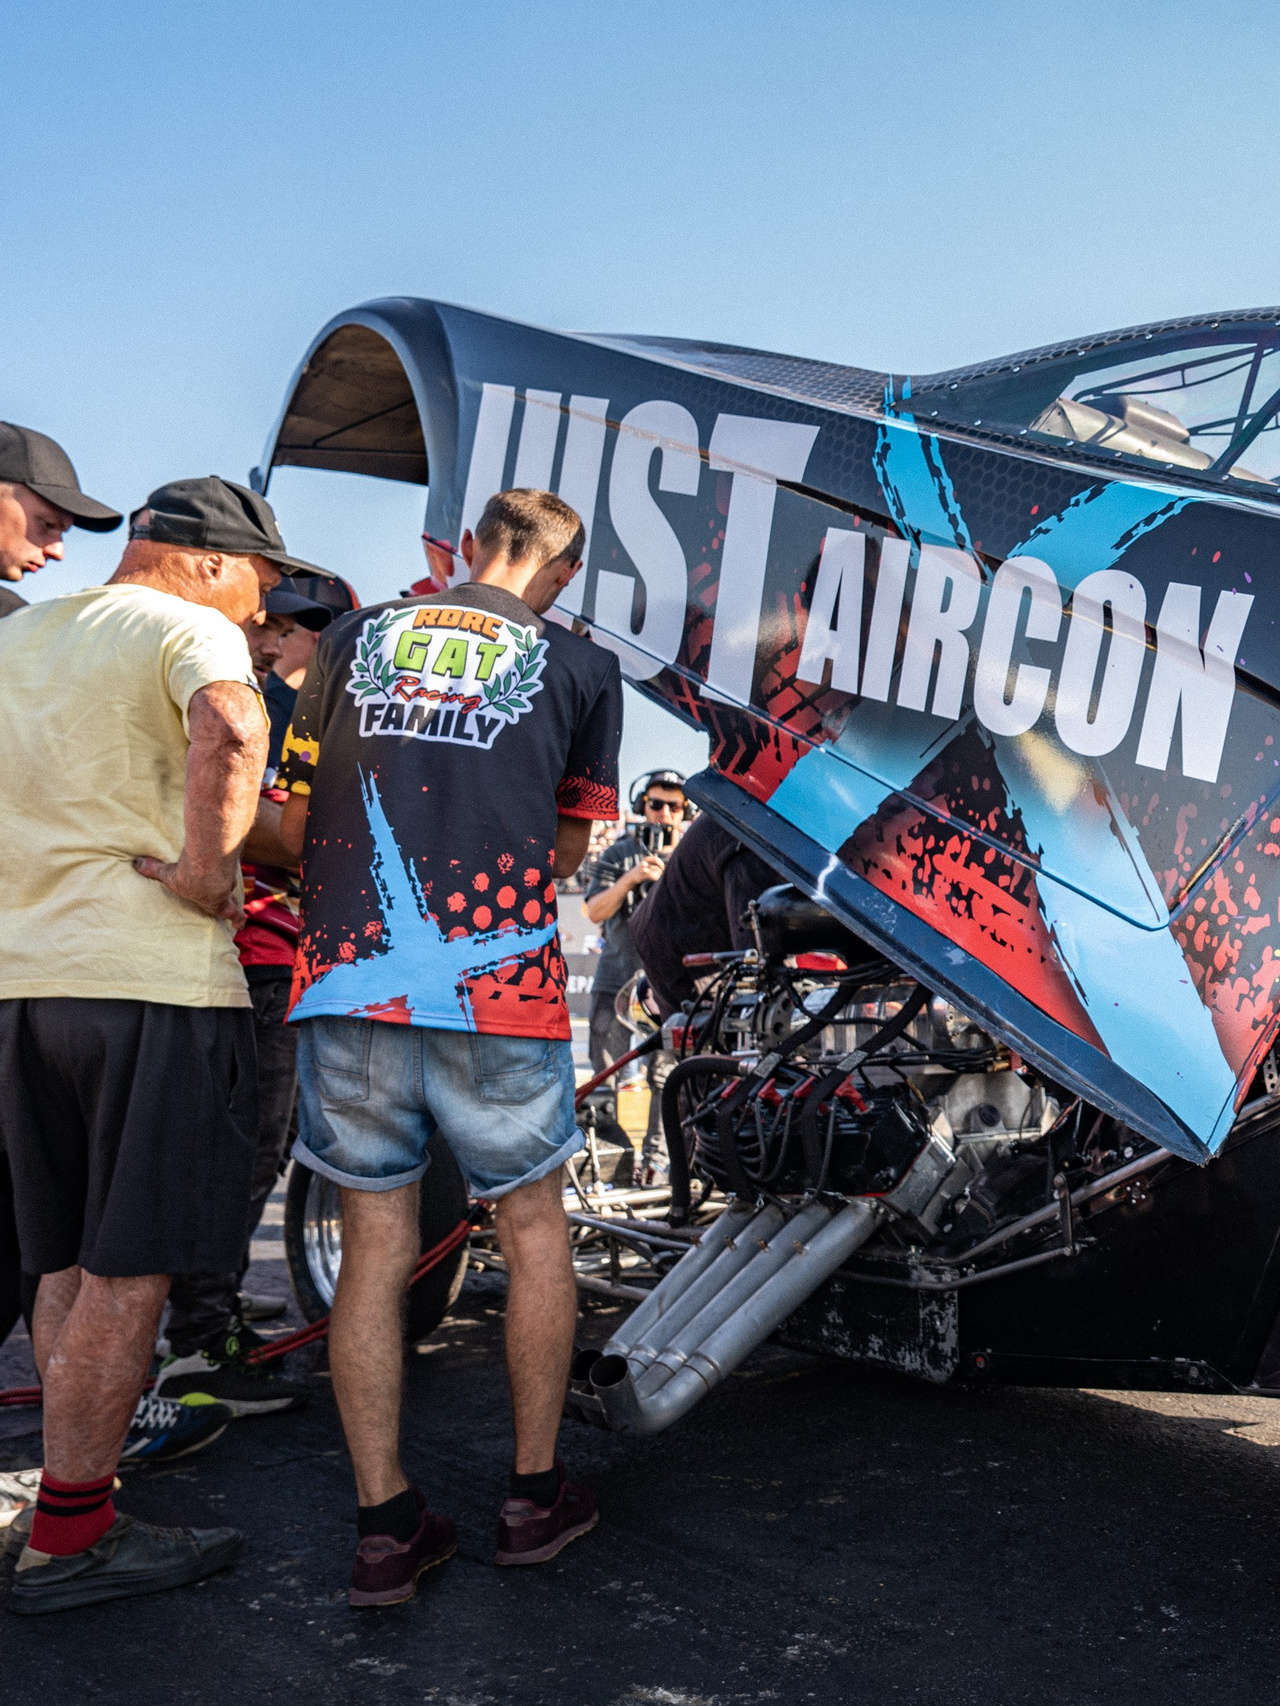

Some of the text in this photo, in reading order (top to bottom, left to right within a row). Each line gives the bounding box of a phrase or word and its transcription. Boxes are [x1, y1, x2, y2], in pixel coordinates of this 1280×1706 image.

[393, 630, 507, 680] GAT
[796, 527, 1255, 783] AIRCON
[392, 675, 482, 714] Racing
[364, 703, 500, 743] FAMILY
